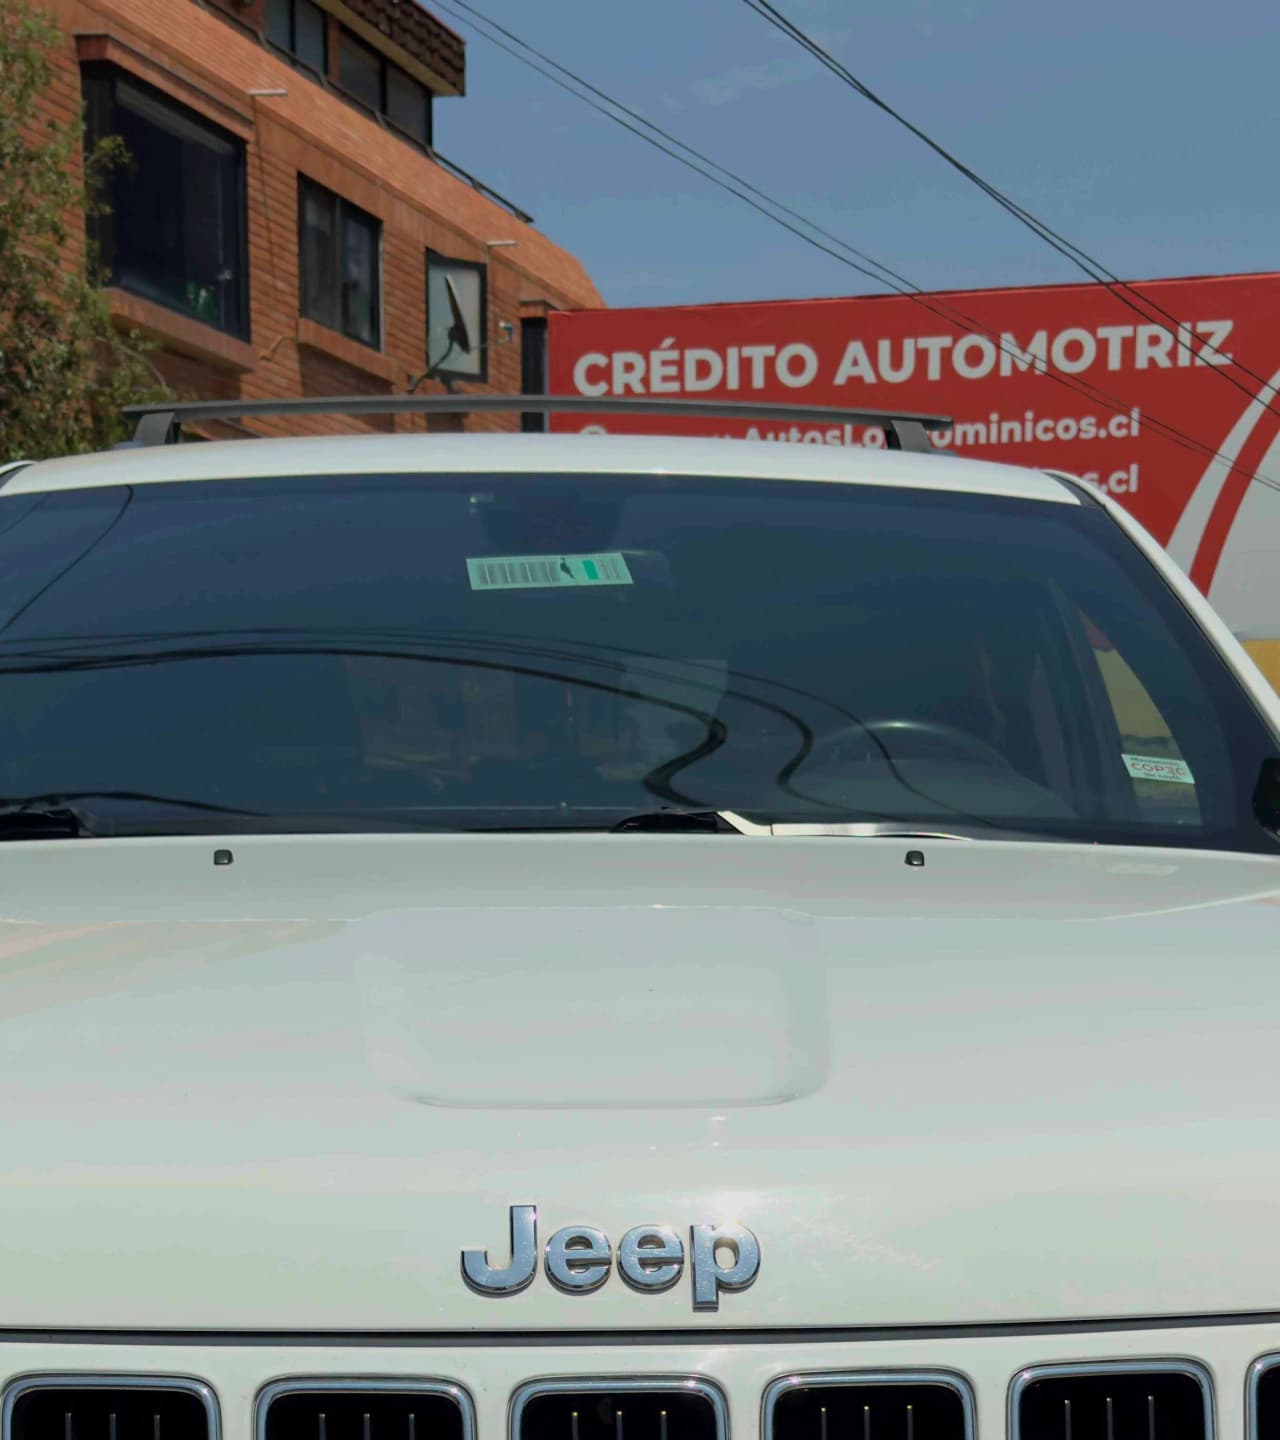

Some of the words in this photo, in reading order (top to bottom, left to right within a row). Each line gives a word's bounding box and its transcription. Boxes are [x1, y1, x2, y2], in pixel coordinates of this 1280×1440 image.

[573, 337, 818, 396] CRÉDITO
[833, 320, 1233, 385] AUTOMOTRIZ
[460, 1204, 762, 1312] Jeep
